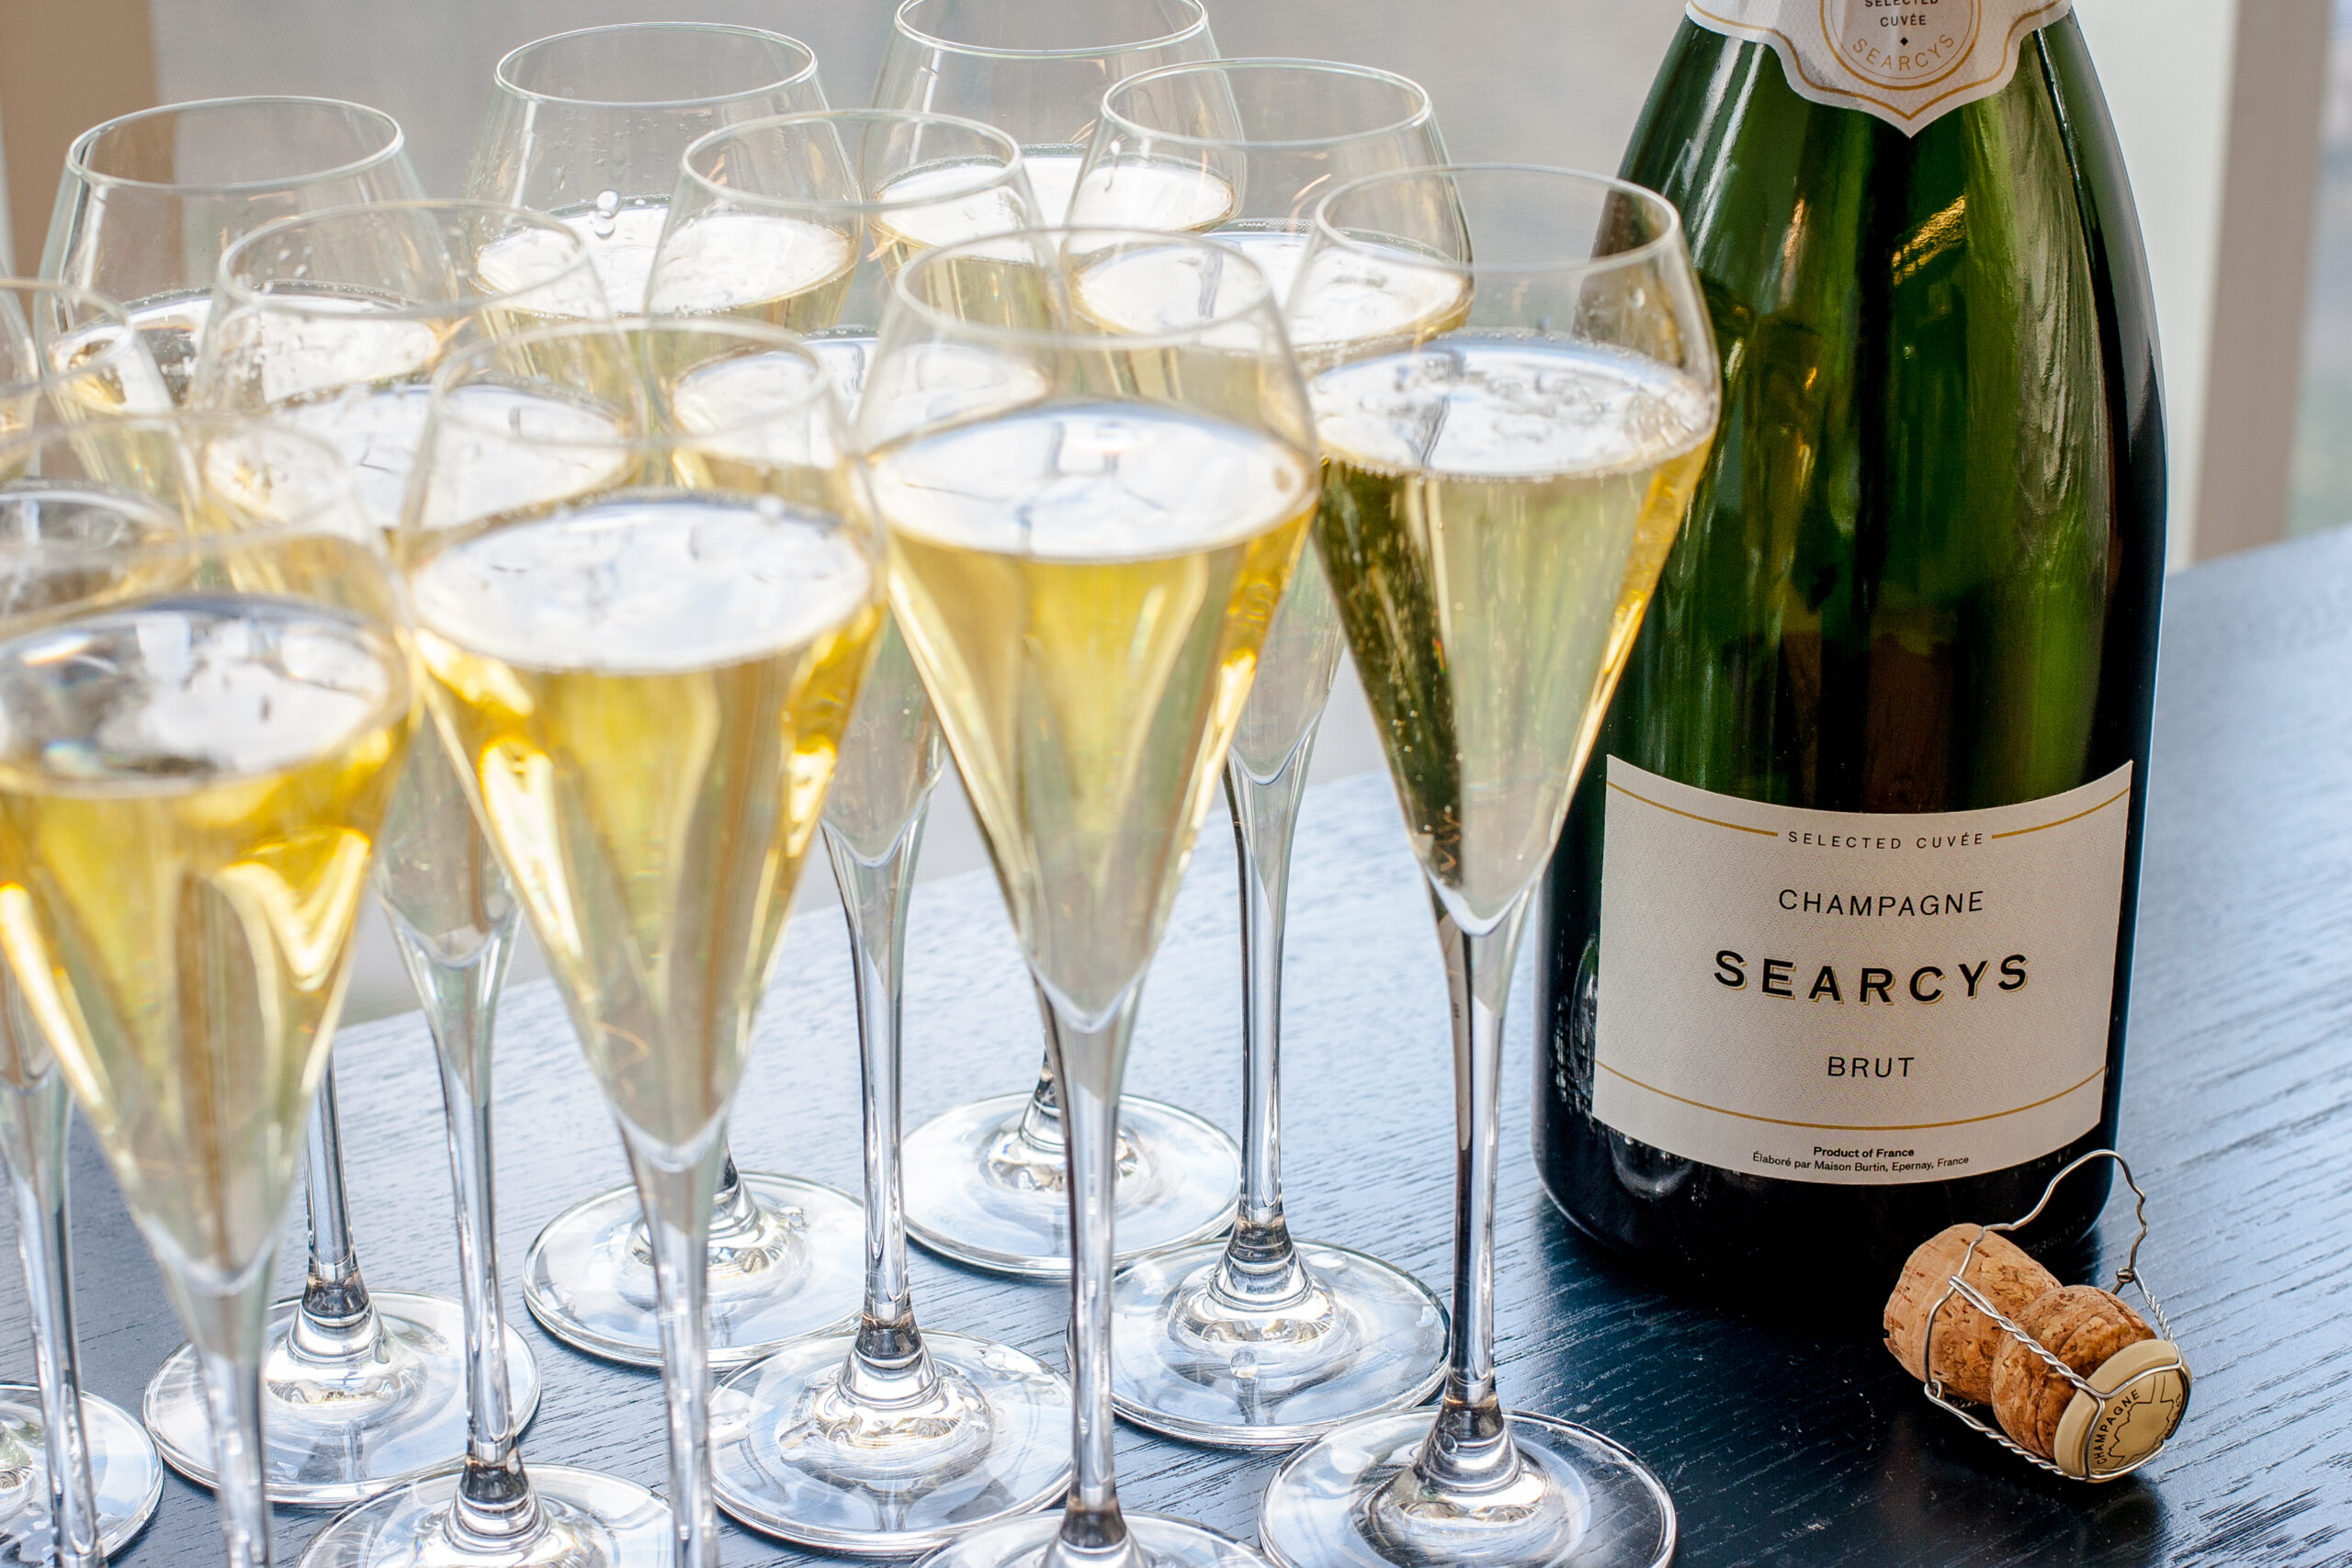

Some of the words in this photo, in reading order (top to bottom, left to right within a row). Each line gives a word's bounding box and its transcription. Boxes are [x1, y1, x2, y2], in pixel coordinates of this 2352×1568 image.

[1880, 13, 1927, 27] CUVÉE
[1852, 34, 1954, 72] SEARCYS
[1788, 830, 1902, 850] SELECTED
[1916, 832, 1984, 850] CUVÉE
[1778, 888, 1984, 917] CHAMPAGNE
[1713, 950, 2029, 1006] SEARCYS
[1826, 1055, 1916, 1078] BRUT
[1752, 1150, 1792, 1167] Élaboré
[1793, 1160, 1812, 1170] par
[1814, 1160, 1852, 1171] Maison
[1854, 1162, 1889, 1173] Burtin,
[1891, 1160, 1935, 1172] Epernay,
[1937, 1156, 1969, 1168] France
[1813, 1145, 1860, 1158] Product
[1861, 1147, 1874, 1158] of
[1875, 1148, 1915, 1158] France
[2094, 1389, 2141, 1465] CHAMPAGNE
